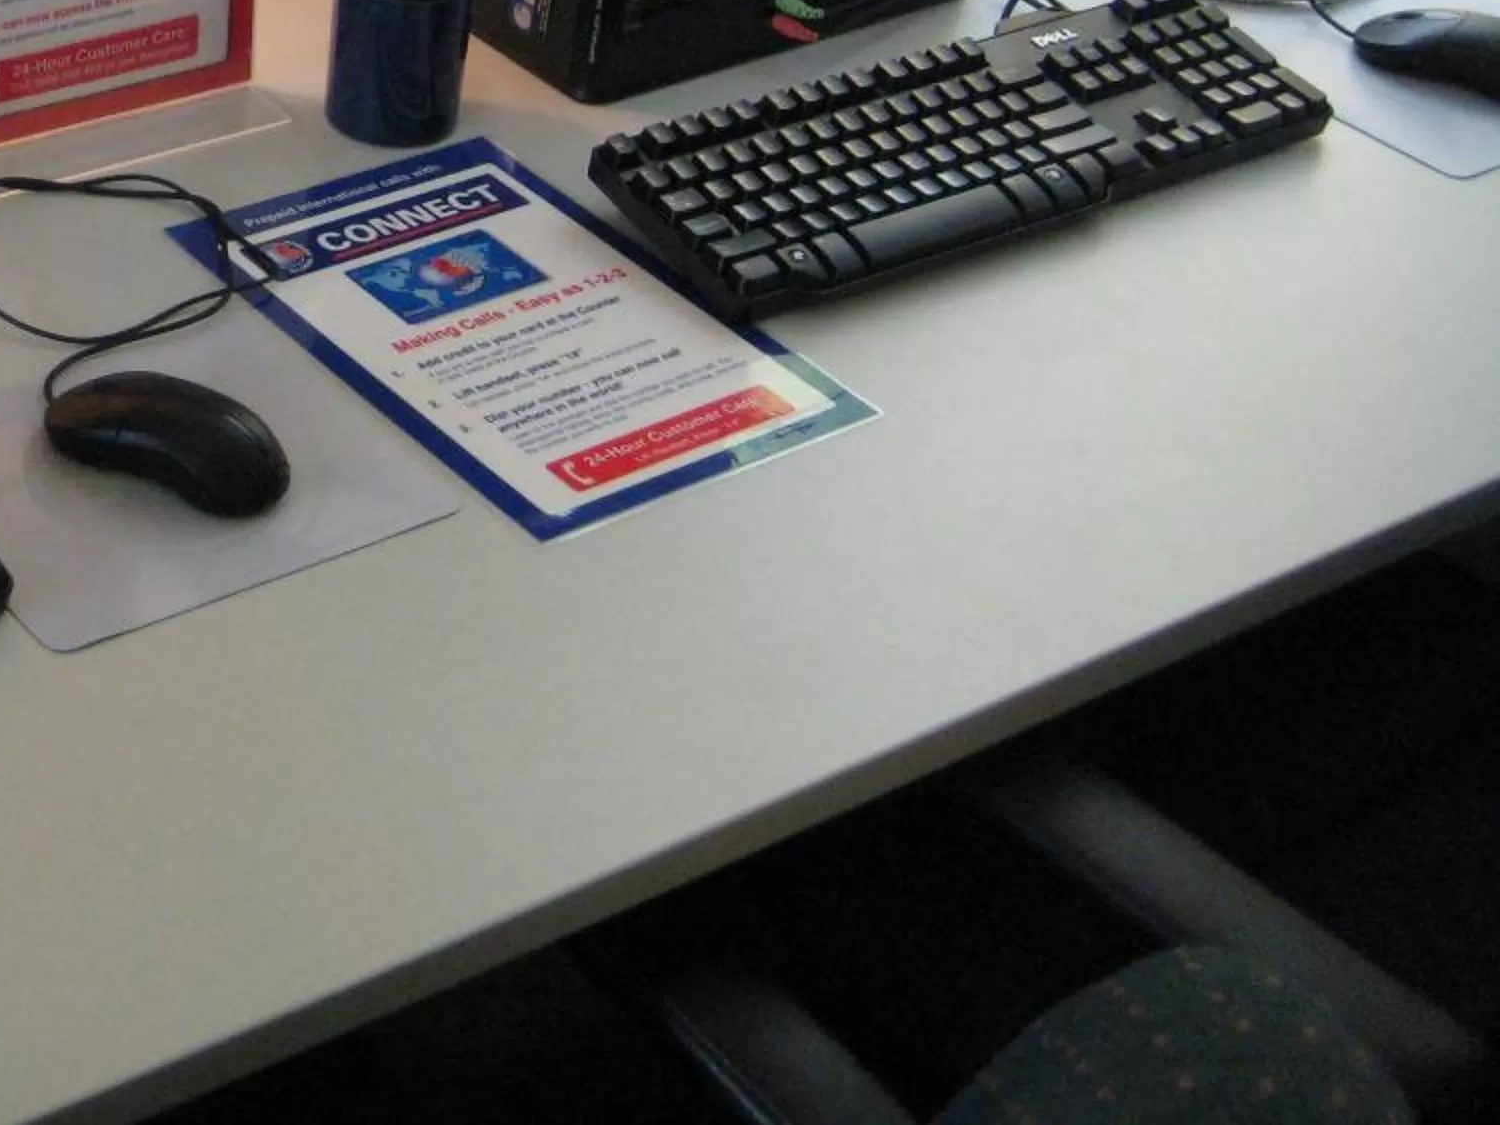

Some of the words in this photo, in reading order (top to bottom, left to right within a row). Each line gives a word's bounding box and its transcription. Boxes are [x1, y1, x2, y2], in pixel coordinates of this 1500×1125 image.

[74, 35, 149, 64] Customer
[1031, 28, 1080, 51] DELL
[243, 205, 297, 228] Prepaid
[317, 183, 500, 252] CONNECT
[391, 325, 462, 355] Making
[459, 309, 506, 331] Calls
[514, 292, 562, 313] Easy
[563, 283, 585, 298] as
[583, 268, 628, 288] 1-2-3
[583, 440, 646, 469] 24-Hour
[647, 408, 722, 444] Customer
